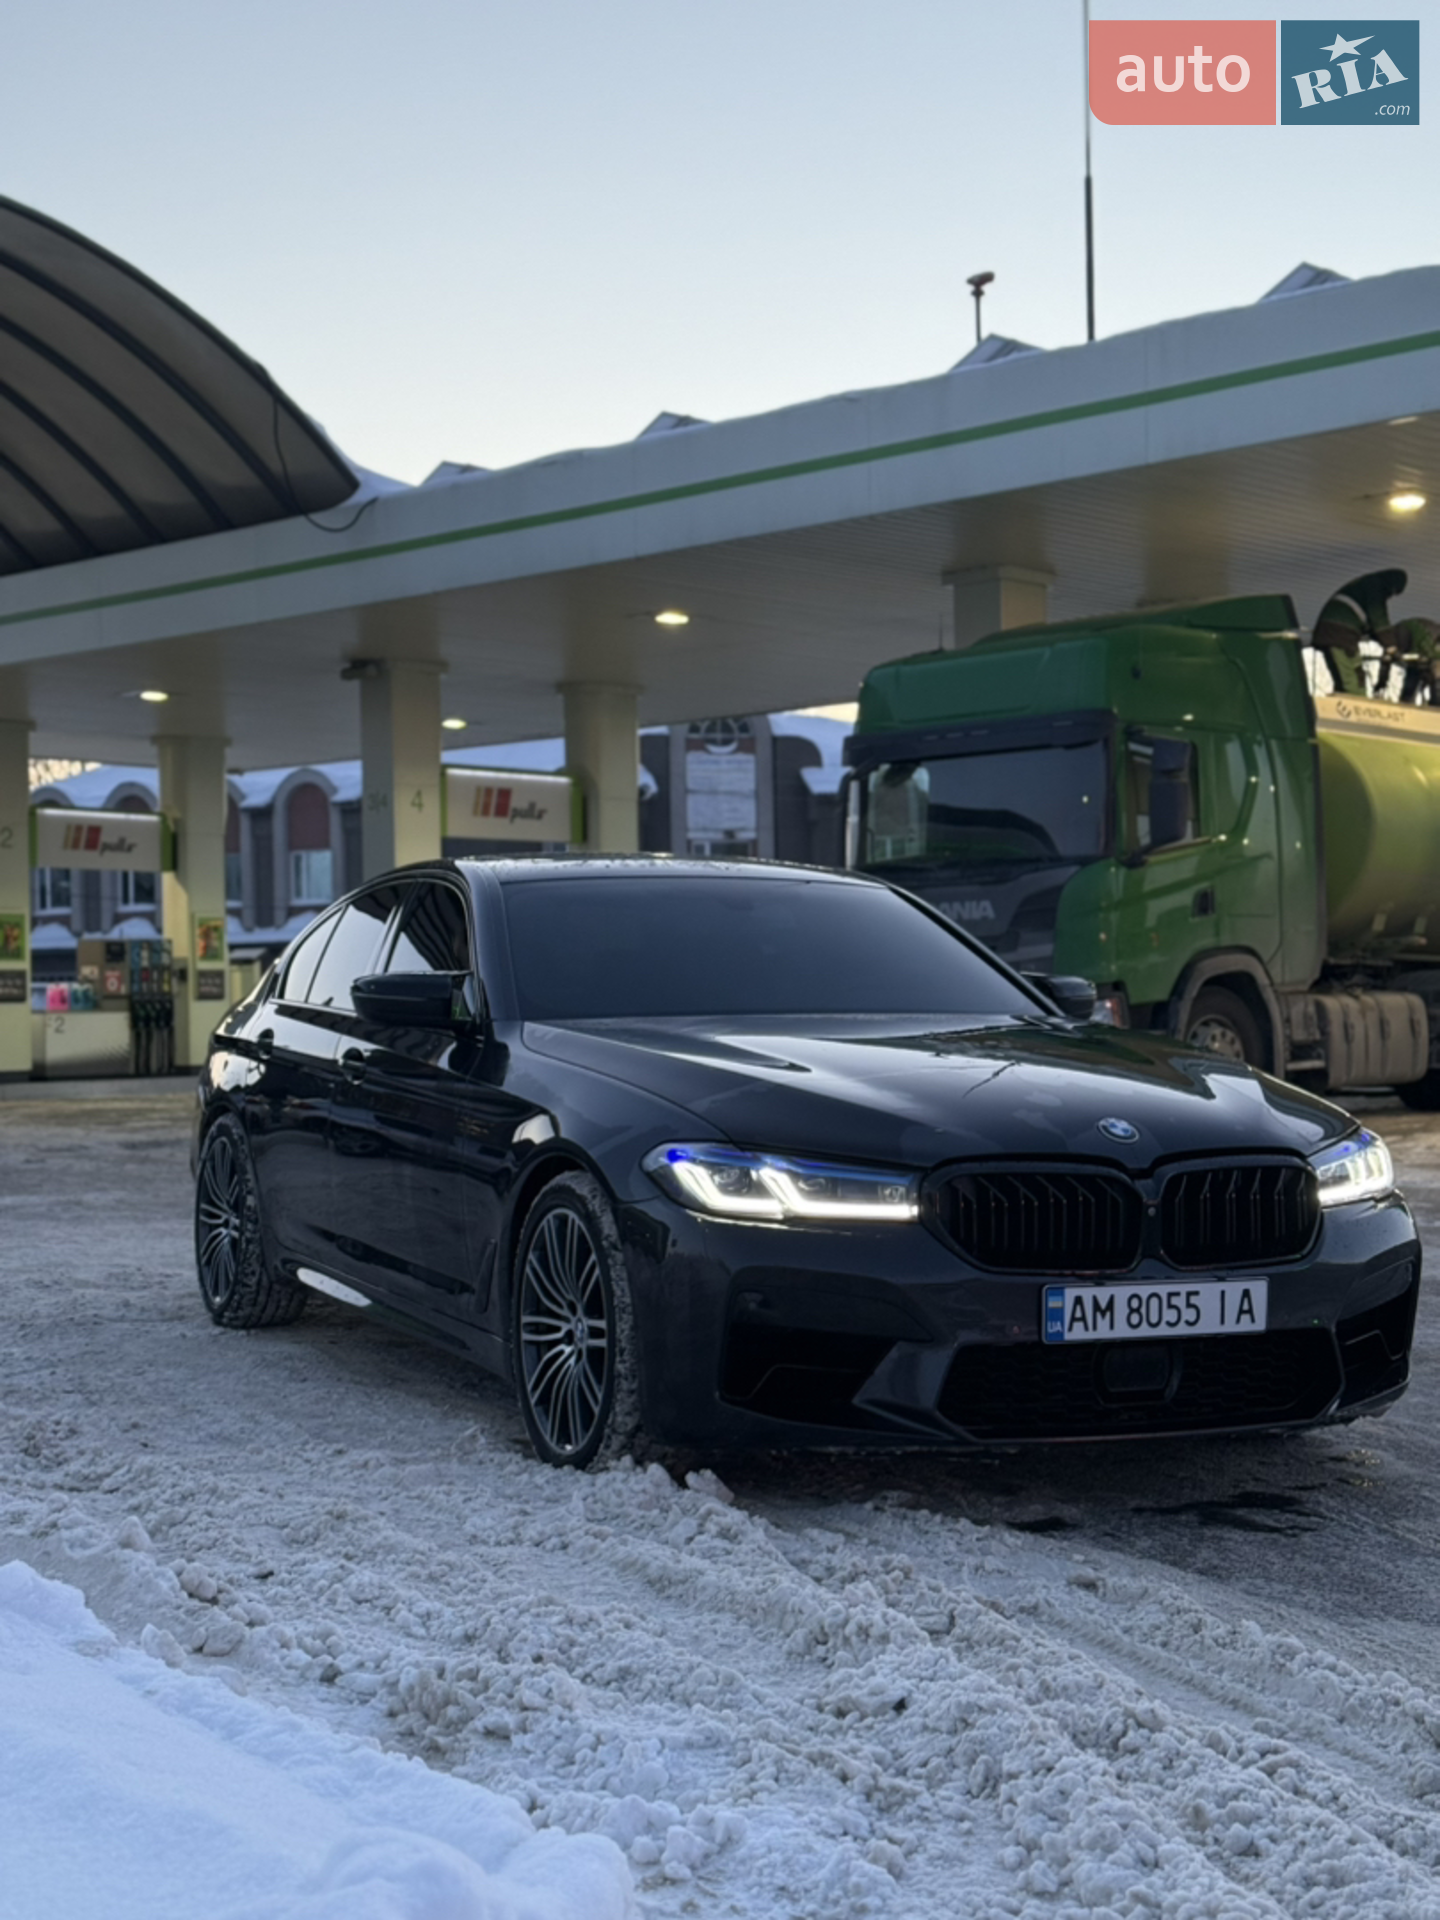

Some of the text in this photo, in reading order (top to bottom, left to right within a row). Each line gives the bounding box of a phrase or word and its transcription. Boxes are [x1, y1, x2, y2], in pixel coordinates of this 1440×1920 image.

[1353, 705, 1405, 722] EVERLAST
[411, 789, 425, 813] 4
[0, 826, 13, 849] 2
[54, 1016, 66, 1034] 2
[1067, 1294, 1115, 1333] AM
[1126, 1291, 1201, 1329] 8055
[1047, 1320, 1064, 1333] UA
